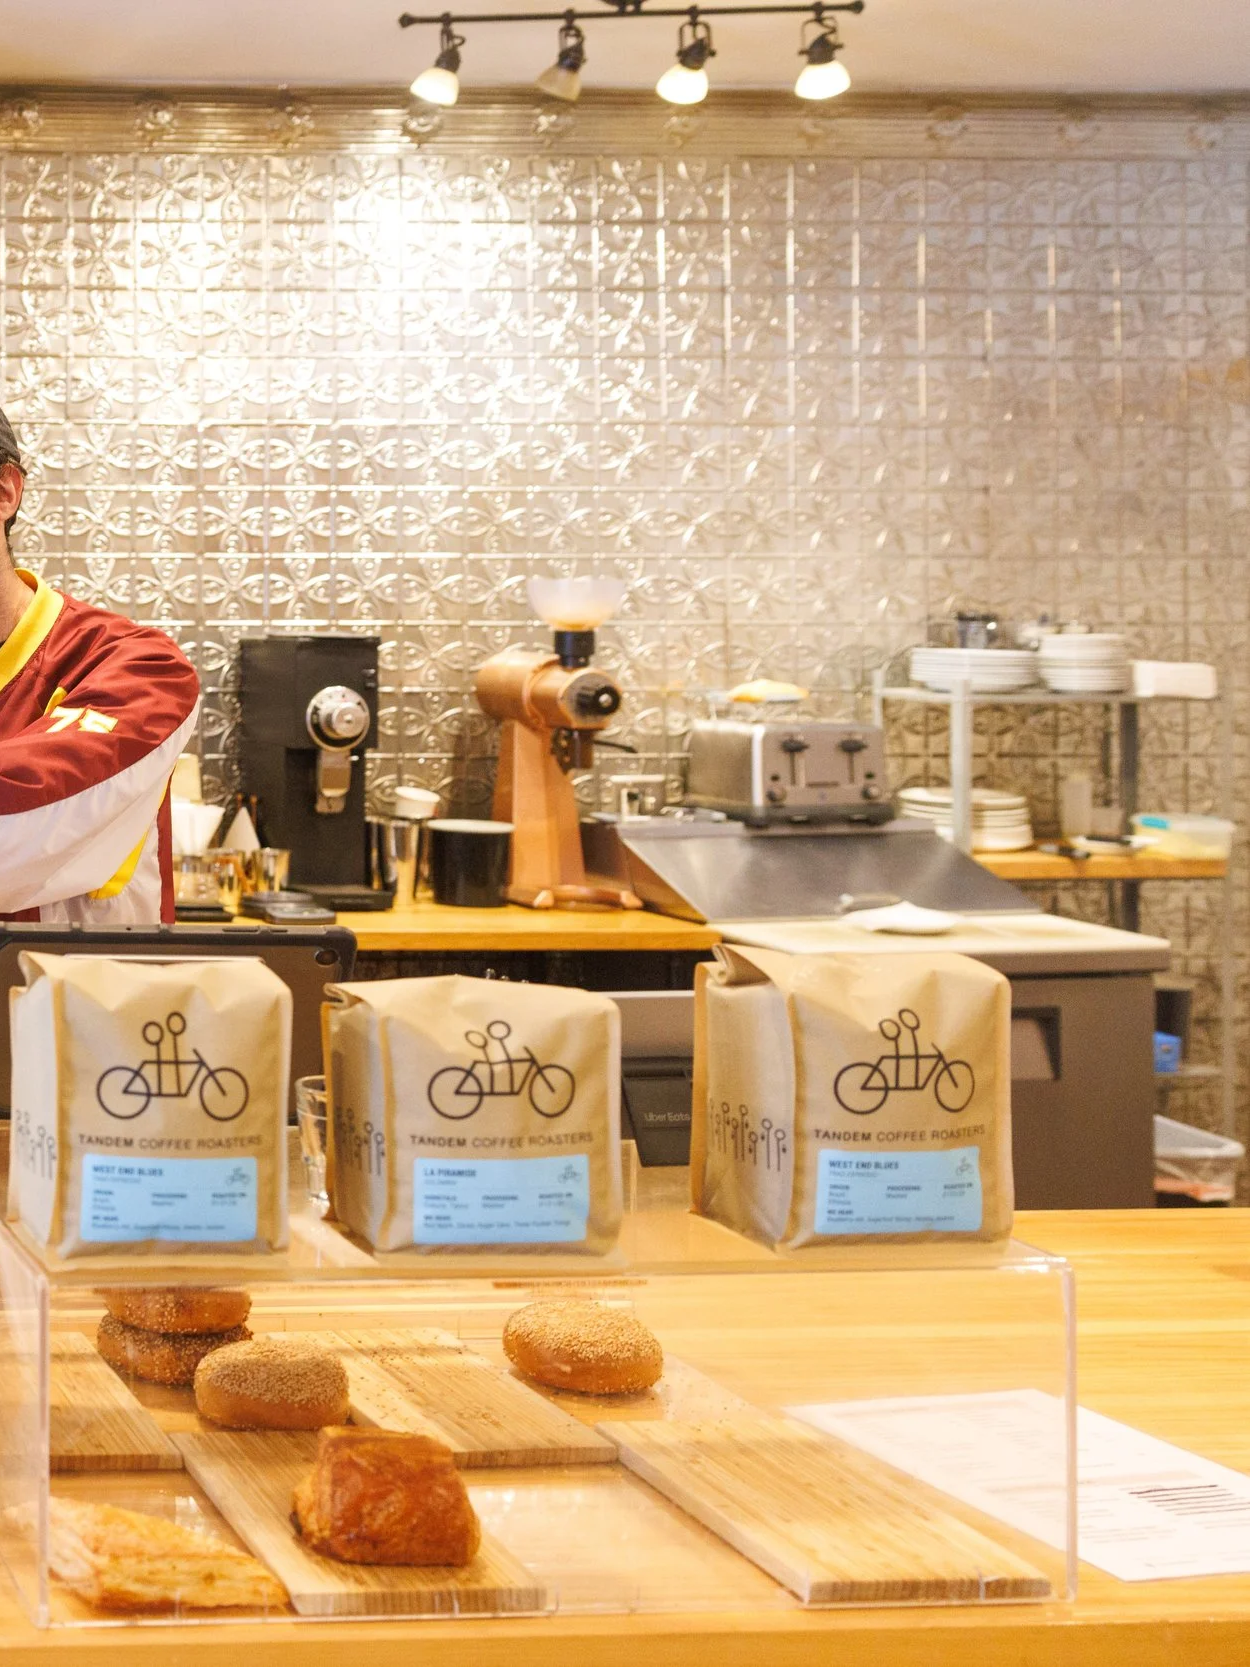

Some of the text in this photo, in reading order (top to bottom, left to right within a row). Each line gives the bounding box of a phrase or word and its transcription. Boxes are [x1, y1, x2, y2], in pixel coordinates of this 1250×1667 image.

[78, 1134, 263, 1150] TANDEM COFFEE ROASTERS
[410, 1132, 593, 1149] TANDEM COFFEE ROASTERS
[814, 1124, 986, 1143] TANDEM COFFEE ROASTERS
